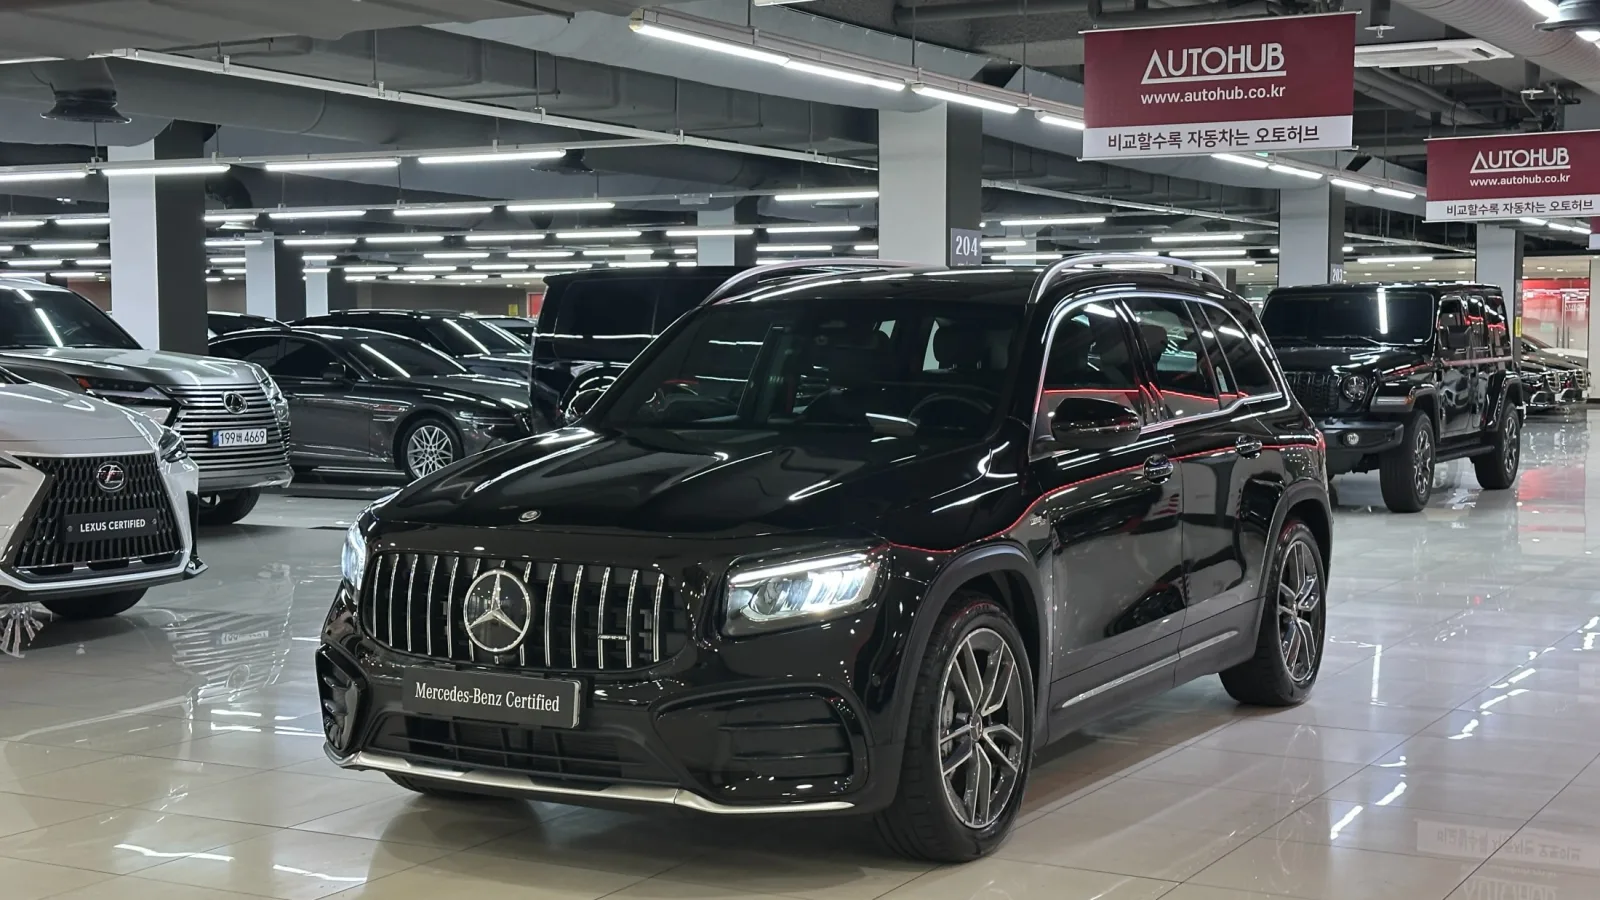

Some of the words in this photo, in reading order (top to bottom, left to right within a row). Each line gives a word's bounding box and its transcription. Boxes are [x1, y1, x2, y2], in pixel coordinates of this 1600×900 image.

[1140, 43, 1287, 85] AUTOHUB
[1140, 84, 1287, 105] www.autohub.co.kr
[1108, 131, 1183, 151] 비교할수록
[1187, 128, 1251, 148] 자동차는
[1254, 125, 1320, 145] 오토허브
[1470, 147, 1571, 174] AUTOHUB
[1470, 173, 1571, 187] www.autohub.co.kr
[1446, 203, 1500, 216] 비교할수록
[1502, 201, 1547, 215] 자동차는
[1549, 200, 1594, 212] 오토허브
[955, 235, 978, 256] 204
[244, 430, 265, 443] 4669
[80, 521, 107, 533] LEXUS
[108, 519, 146, 530] CERTIFIED
[415, 682, 502, 707] Mercedes-Benz
[505, 690, 560, 712] Certified
